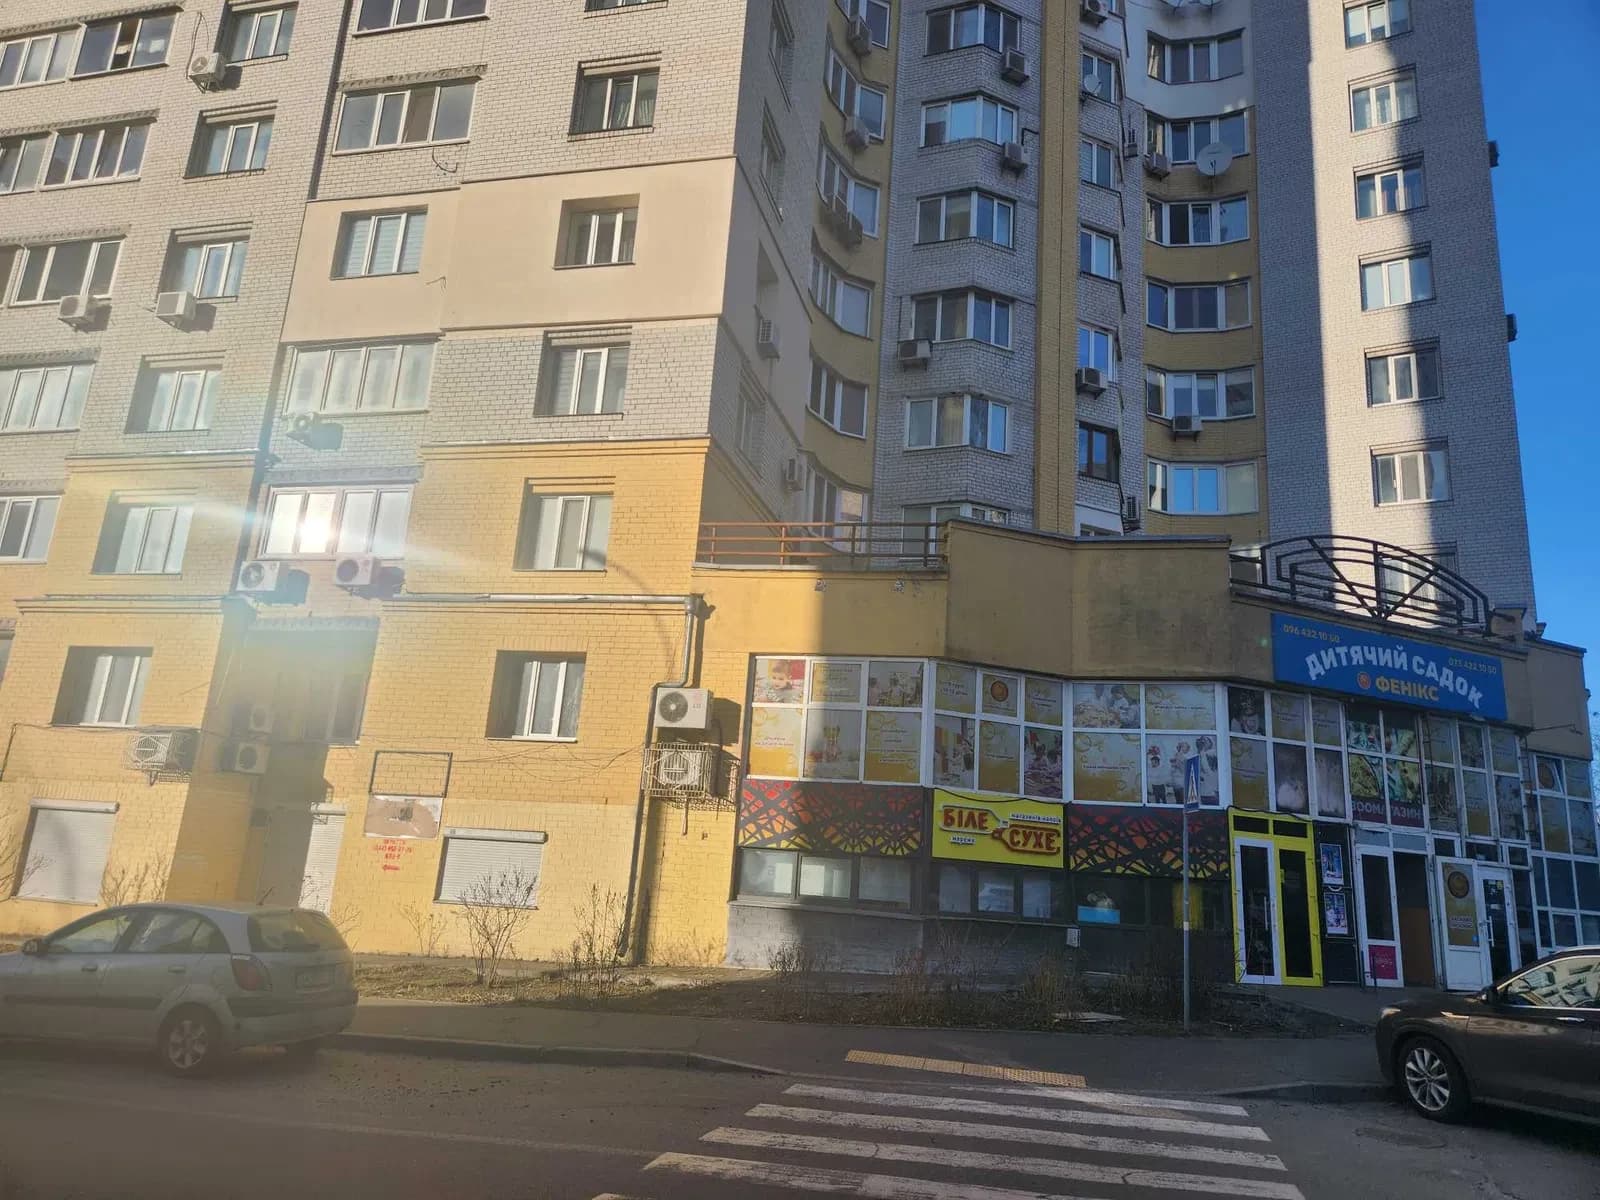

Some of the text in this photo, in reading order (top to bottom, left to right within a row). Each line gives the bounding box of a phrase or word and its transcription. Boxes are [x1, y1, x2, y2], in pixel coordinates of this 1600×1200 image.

[1319, 631, 1328, 641] 10
[1304, 644, 1483, 709] ДИТЯЧИЙ САДОК
[1375, 675, 1440, 701] ФЕНІКС
[943, 807, 989, 830] БІЛЕ
[1009, 828, 1057, 851] СУХЕ
